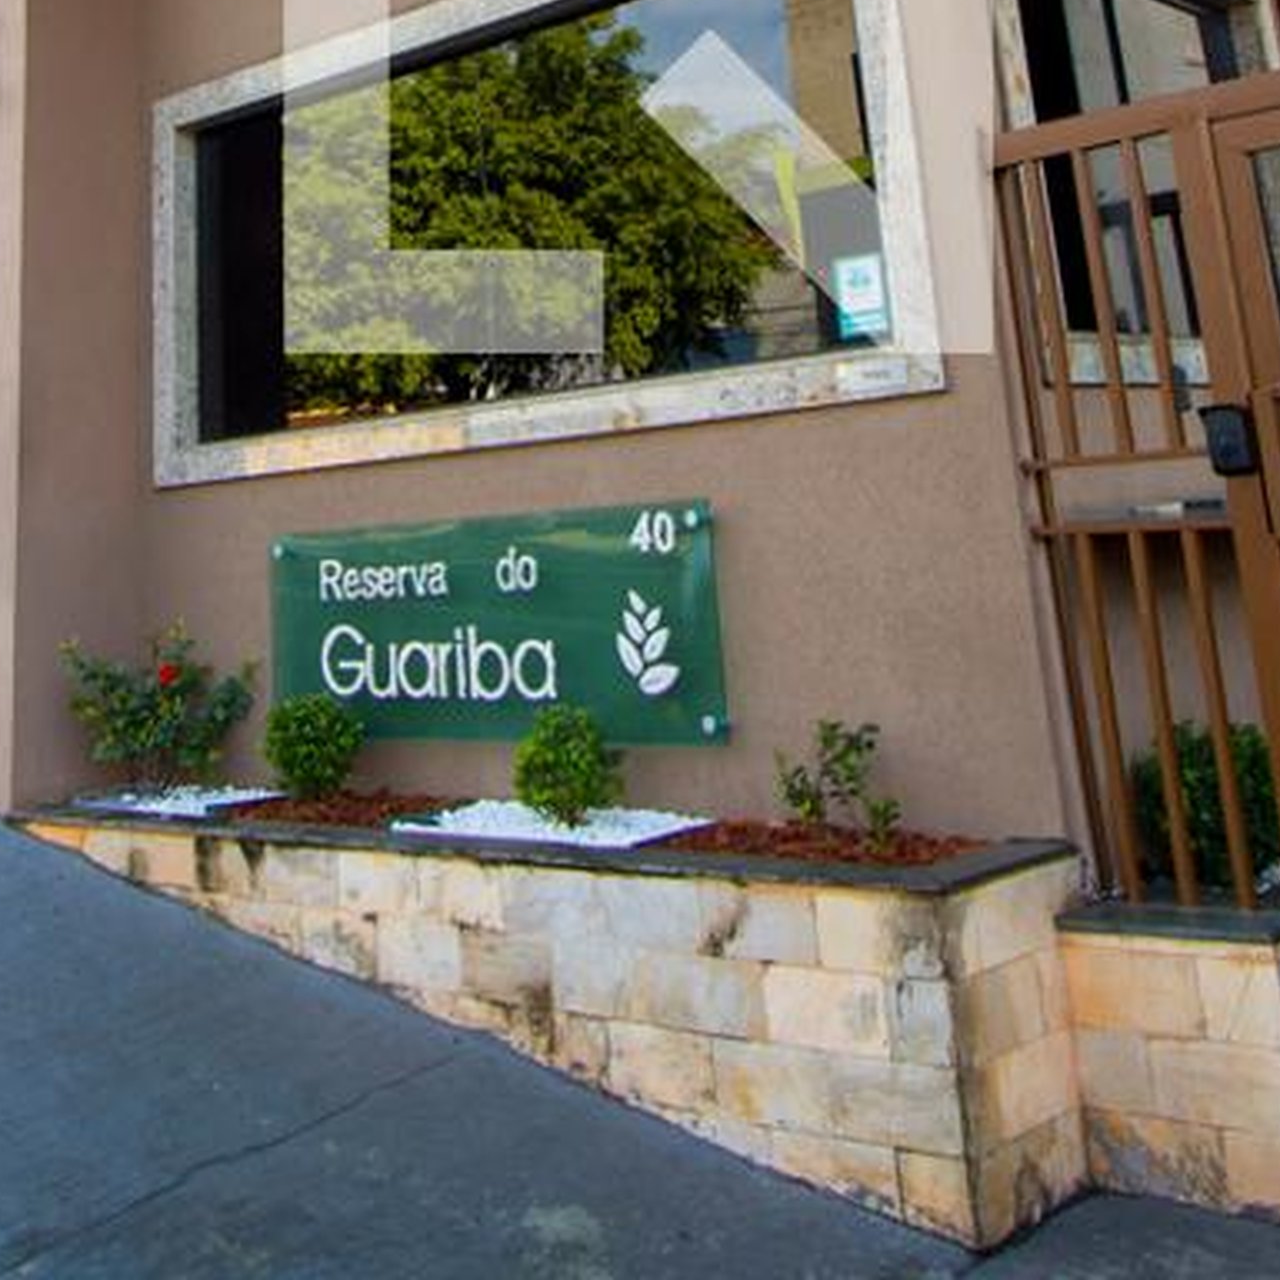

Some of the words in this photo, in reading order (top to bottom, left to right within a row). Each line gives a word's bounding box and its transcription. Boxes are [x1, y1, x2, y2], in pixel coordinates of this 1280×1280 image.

[630, 510, 675, 553] 40
[319, 558, 448, 601] Reserva
[495, 546, 538, 592] do
[320, 624, 558, 700] Guariba
